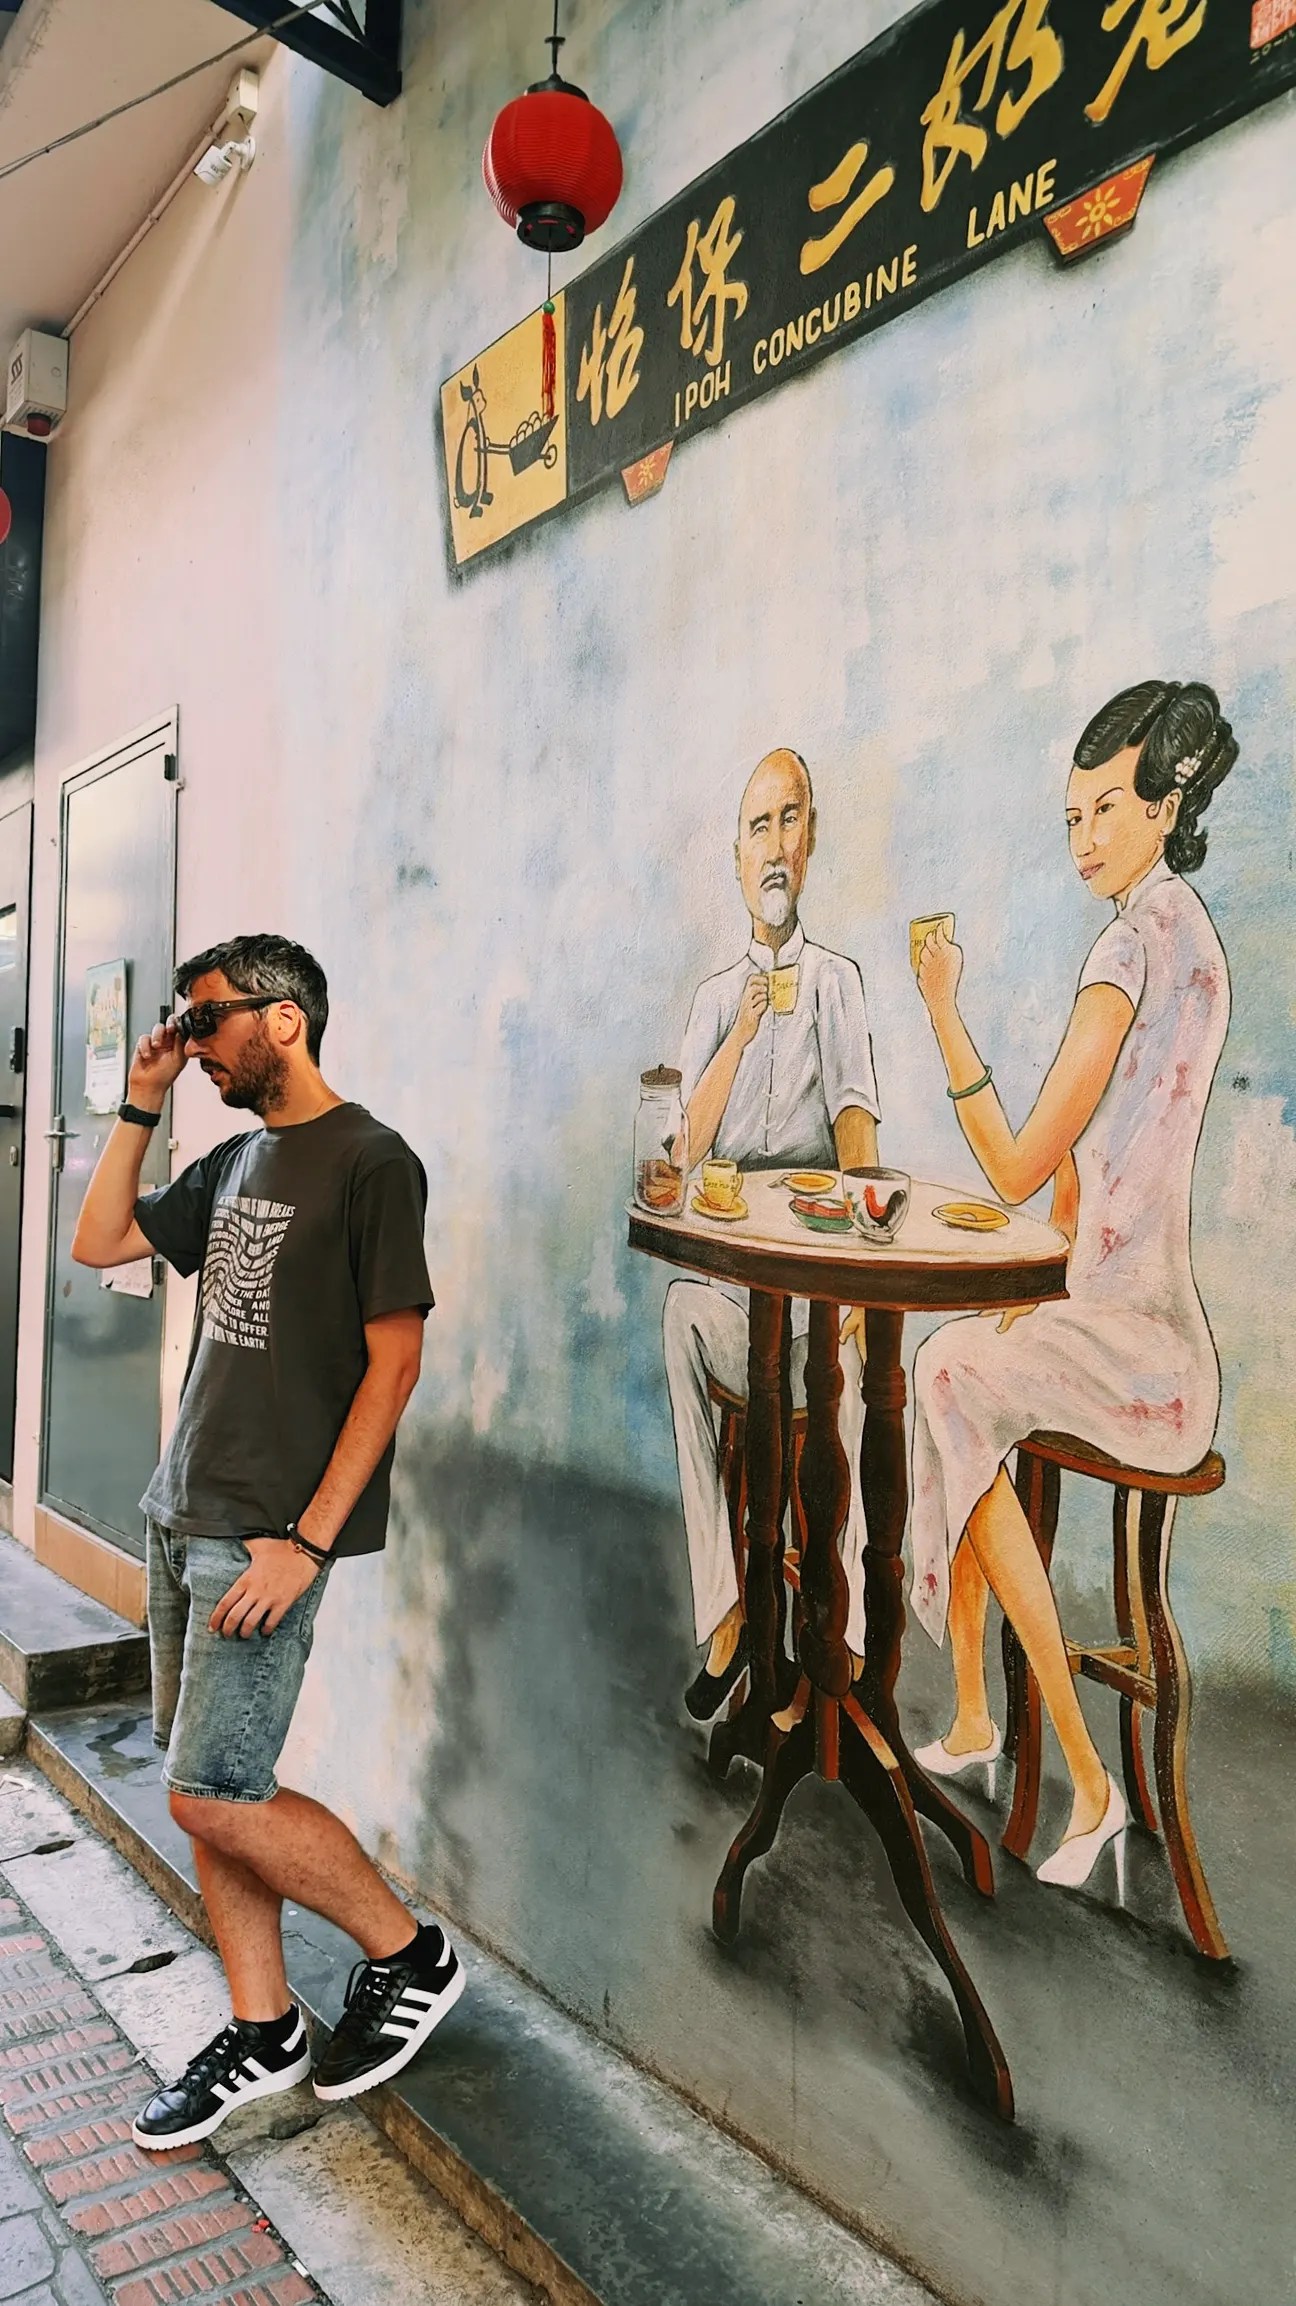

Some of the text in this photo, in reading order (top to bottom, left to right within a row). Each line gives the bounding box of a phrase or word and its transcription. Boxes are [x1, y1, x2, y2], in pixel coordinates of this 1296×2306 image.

[673, 158, 1057, 428] IPOH CONCUBINE LANE
[239, 1286, 271, 1299] THE DAY
[221, 1299, 270, 1323] EXPLORE ALL
[251, 1300, 271, 1311] AND
[228, 1316, 238, 1330] TO
[239, 1321, 269, 1337] OFFER.
[238, 1334, 267, 1351] EARTH.
